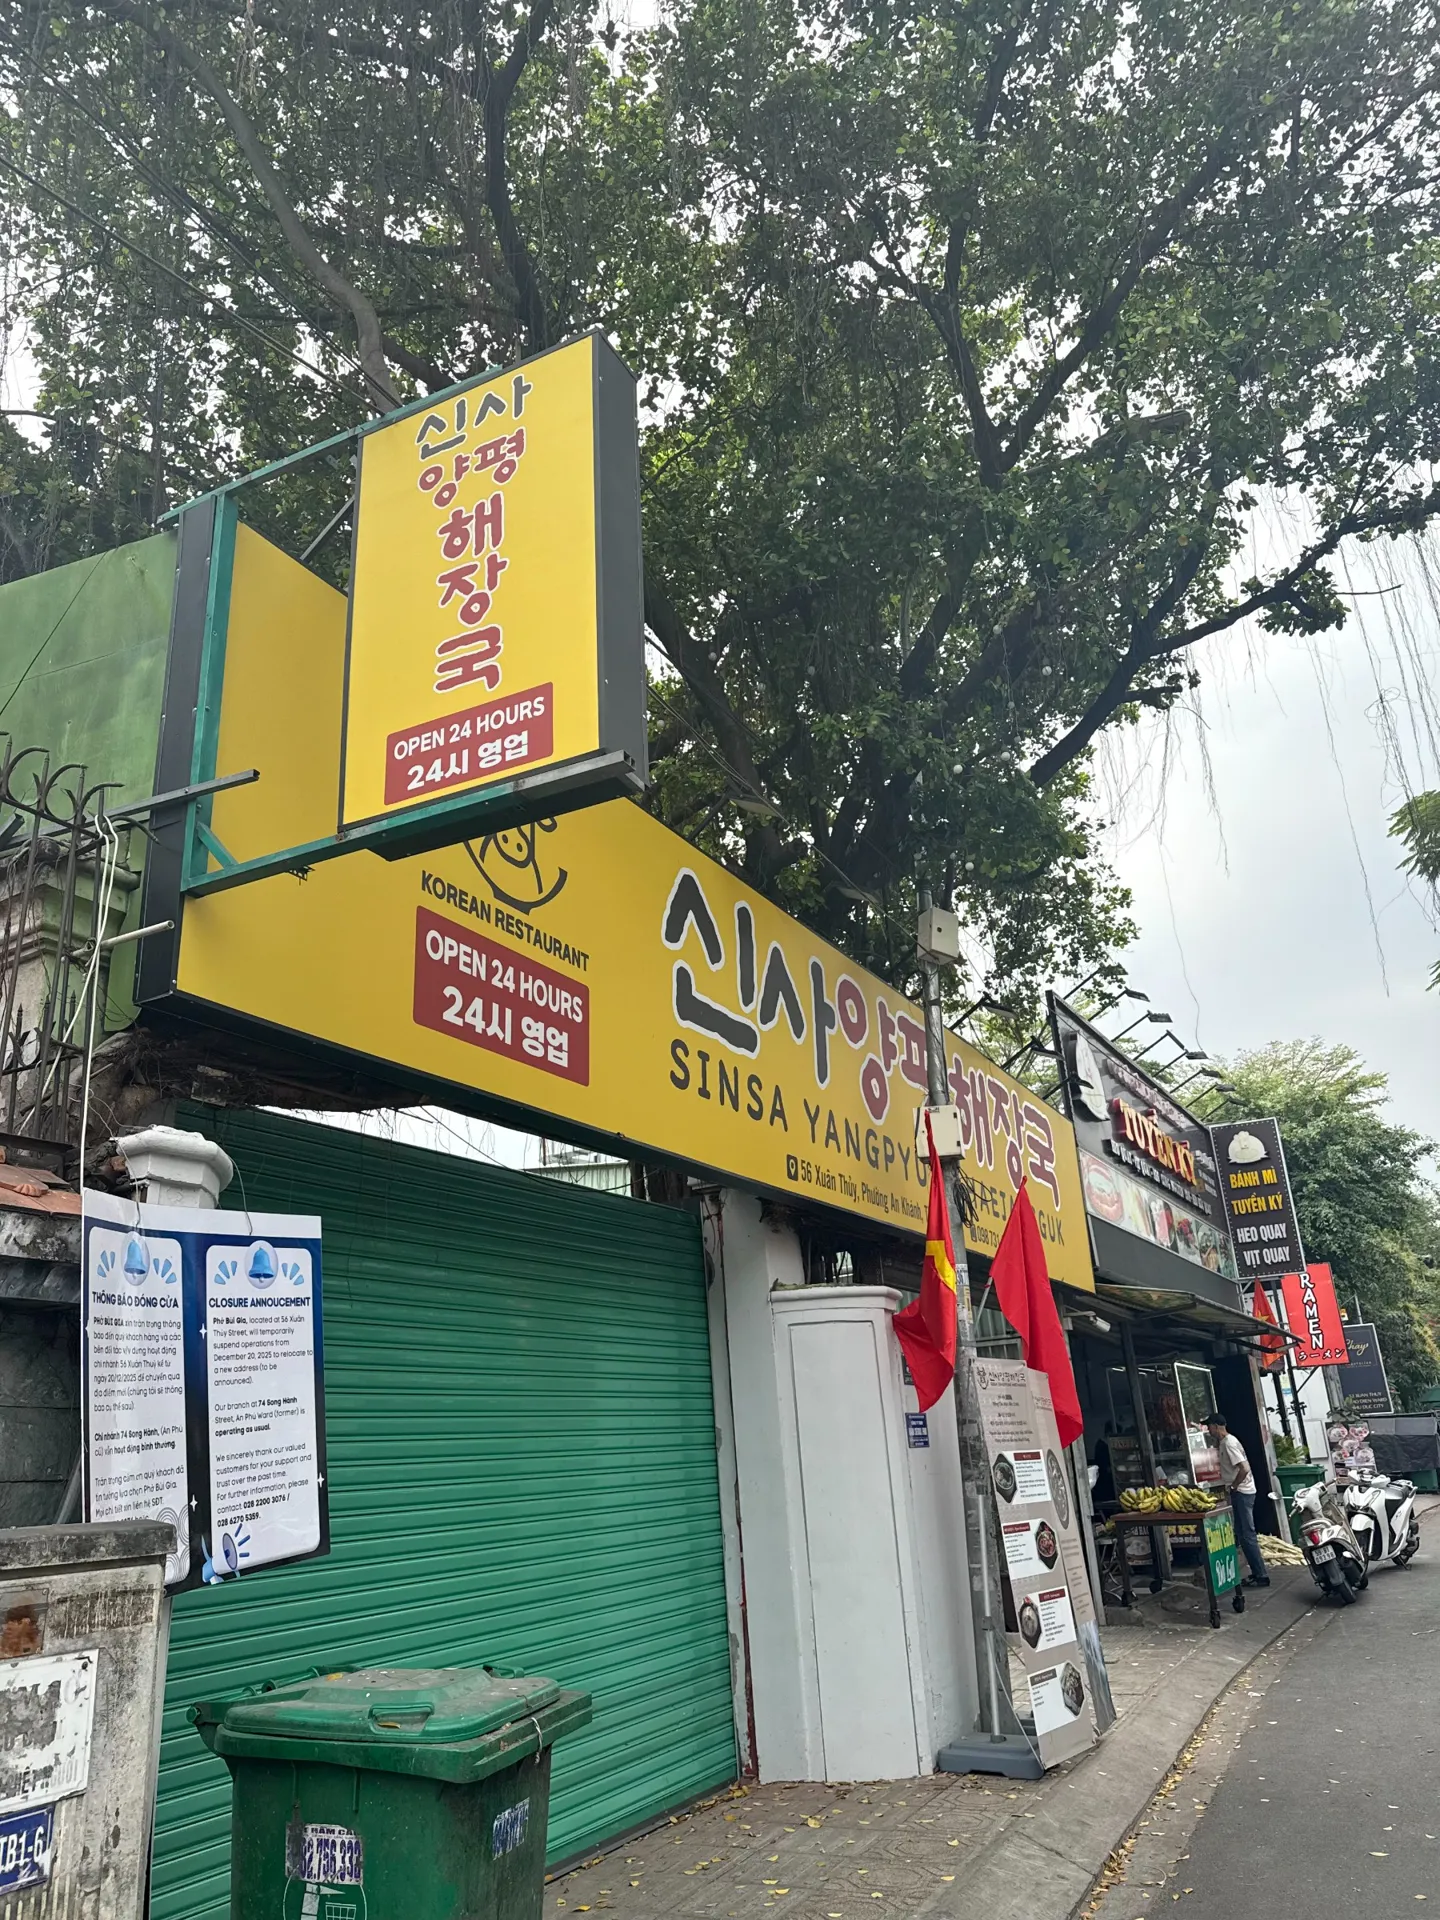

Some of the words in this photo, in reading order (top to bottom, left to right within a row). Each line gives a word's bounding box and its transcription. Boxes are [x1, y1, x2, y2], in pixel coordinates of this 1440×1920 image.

[415, 373, 533, 460] 신사
[417, 426, 526, 508] 양평
[393, 727, 444, 761] OPEN
[448, 717, 472, 743] 24
[476, 694, 545, 736] HOURS
[406, 749, 469, 792] 24시
[477, 729, 529, 769] 영업
[421, 869, 491, 924] KOREAN
[495, 907, 590, 972] RESTAURANT
[425, 929, 487, 982] OPEN
[491, 958, 516, 994] 24
[519, 970, 583, 1024] HOURS
[442, 985, 512, 1045] 24시
[521, 1016, 569, 1068] 영업
[669, 1038, 788, 1133] SINSA
[1229, 1170, 1260, 1189] BÁNH
[1262, 1165, 1278, 1185] MÌ
[800, 1159, 812, 1184] 56
[815, 1164, 836, 1192] Xuân
[838, 1172, 860, 1203] Thủy,
[861, 1181, 889, 1214] Phường
[890, 1192, 900, 1212] An
[901, 1196, 924, 1223] Khánh,
[1231, 1192, 1267, 1215] TUYỀN
[1268, 1191, 1283, 1210] KÝ
[1236, 1226, 1258, 1243] HEO
[1260, 1223, 1287, 1242] QUAY
[1243, 1249, 1261, 1268] VỊT
[1262, 1246, 1290, 1265] QUAY
[92, 1290, 116, 1305] THÔNG
[118, 1293, 133, 1307] BÁO
[134, 1294, 158, 1308] ĐÓNG
[159, 1295, 179, 1309] CỬA
[209, 1297, 249, 1308] CLOSURE
[250, 1297, 311, 1308] ANNOUCEMENT
[249, 1316, 273, 1324] located
[1299, 1273, 1324, 1350] RAMEN
[249, 1328, 259, 1336] will
[259, 1327, 295, 1337] temporarily
[213, 1341, 240, 1350] suspend
[241, 1340, 274, 1349] operations
[275, 1339, 290, 1347] from
[214, 1353, 246, 1362] December
[257, 1351, 272, 1359] 2025
[280, 1349, 306, 1358] relocate
[1298, 1348, 1346, 1361] ラーメン
[233, 1364, 259, 1373] address
[259, 1363, 268, 1372] (to
[214, 1403, 226, 1412] Our
[227, 1401, 250, 1410] branch
[258, 1399, 266, 1407] 74
[267, 1398, 282, 1407] Song
[236, 1414, 244, 1422] An
[257, 1410, 273, 1419] Ward
[274, 1407, 299, 1418] (former)
[121, 1431, 128, 1439] 74
[128, 1430, 143, 1440] Song
[215, 1426, 245, 1437] operating
[215, 1454, 225, 1462] We
[226, 1450, 254, 1461] sincerely
[255, 1447, 273, 1456] thank
[273, 1446, 284, 1454] our
[285, 1443, 306, 1452] valued
[216, 1465, 249, 1476] customers
[250, 1462, 259, 1470] for
[260, 1459, 274, 1470] your
[274, 1457, 299, 1467] support
[299, 1454, 312, 1462] and
[216, 1479, 230, 1488] trust
[231, 1478, 245, 1486] over
[246, 1475, 257, 1483] the
[258, 1473, 272, 1482] past
[216, 1493, 227, 1501] For
[228, 1489, 249, 1499] further
[288, 1479, 309, 1489] please
[243, 1501, 254, 1509] 028
[255, 1498, 271, 1506] 2200
[271, 1495, 286, 1504] 3076
[217, 1518, 229, 1528] 028
[229, 1515, 244, 1525] 6270
